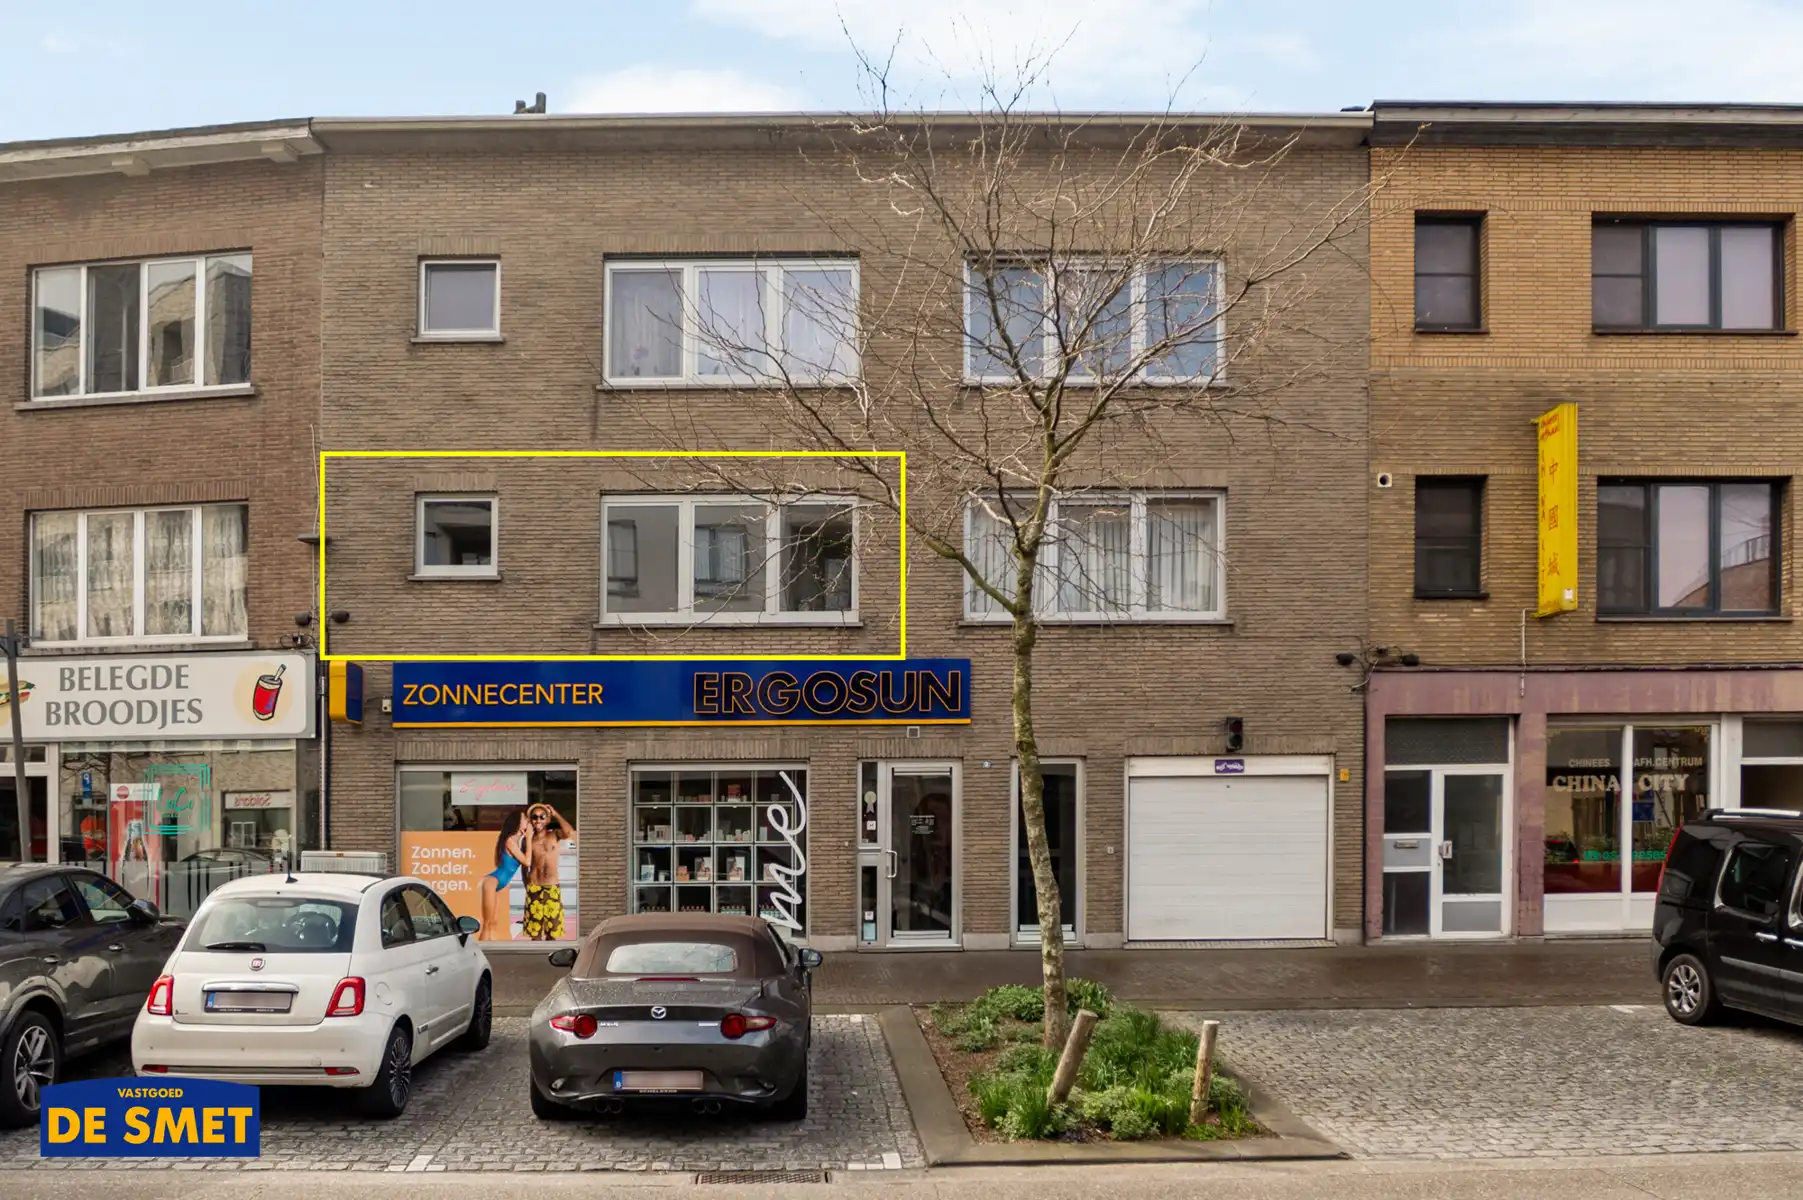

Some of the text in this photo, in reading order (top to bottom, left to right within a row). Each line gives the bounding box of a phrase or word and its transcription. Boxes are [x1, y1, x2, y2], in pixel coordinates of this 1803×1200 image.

[59, 664, 189, 692] BELEGDE
[402, 670, 961, 715] ZONNECENTER ERGOSUN
[45, 698, 203, 730] BROODJES
[1568, 758, 1611, 768] CHINEES
[1552, 773, 1690, 792] CHINA CITY
[411, 846, 476, 859] Zonnen.
[411, 862, 473, 875] Zonder.
